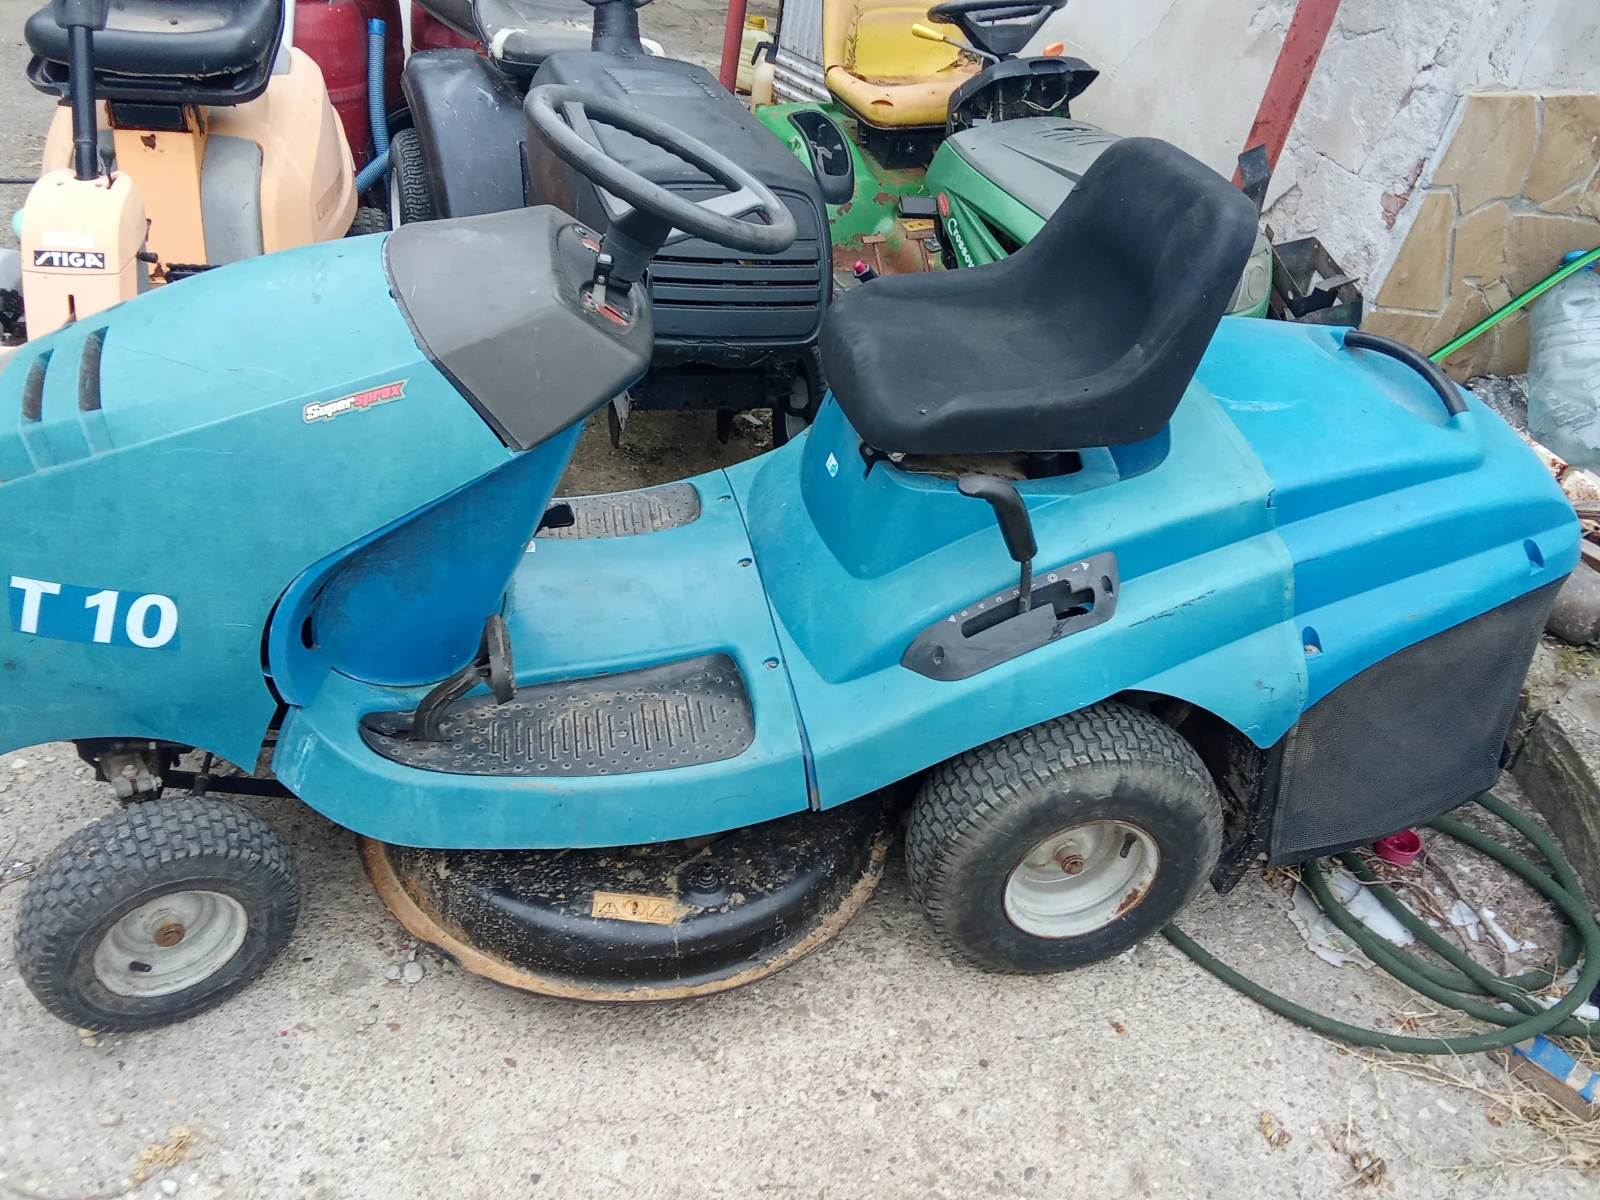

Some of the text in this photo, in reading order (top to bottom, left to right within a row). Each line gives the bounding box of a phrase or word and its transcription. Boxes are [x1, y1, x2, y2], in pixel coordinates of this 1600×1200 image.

[35, 251, 104, 268] STIGA
[305, 382, 403, 421] Supersprox
[10, 575, 178, 648] T 10
